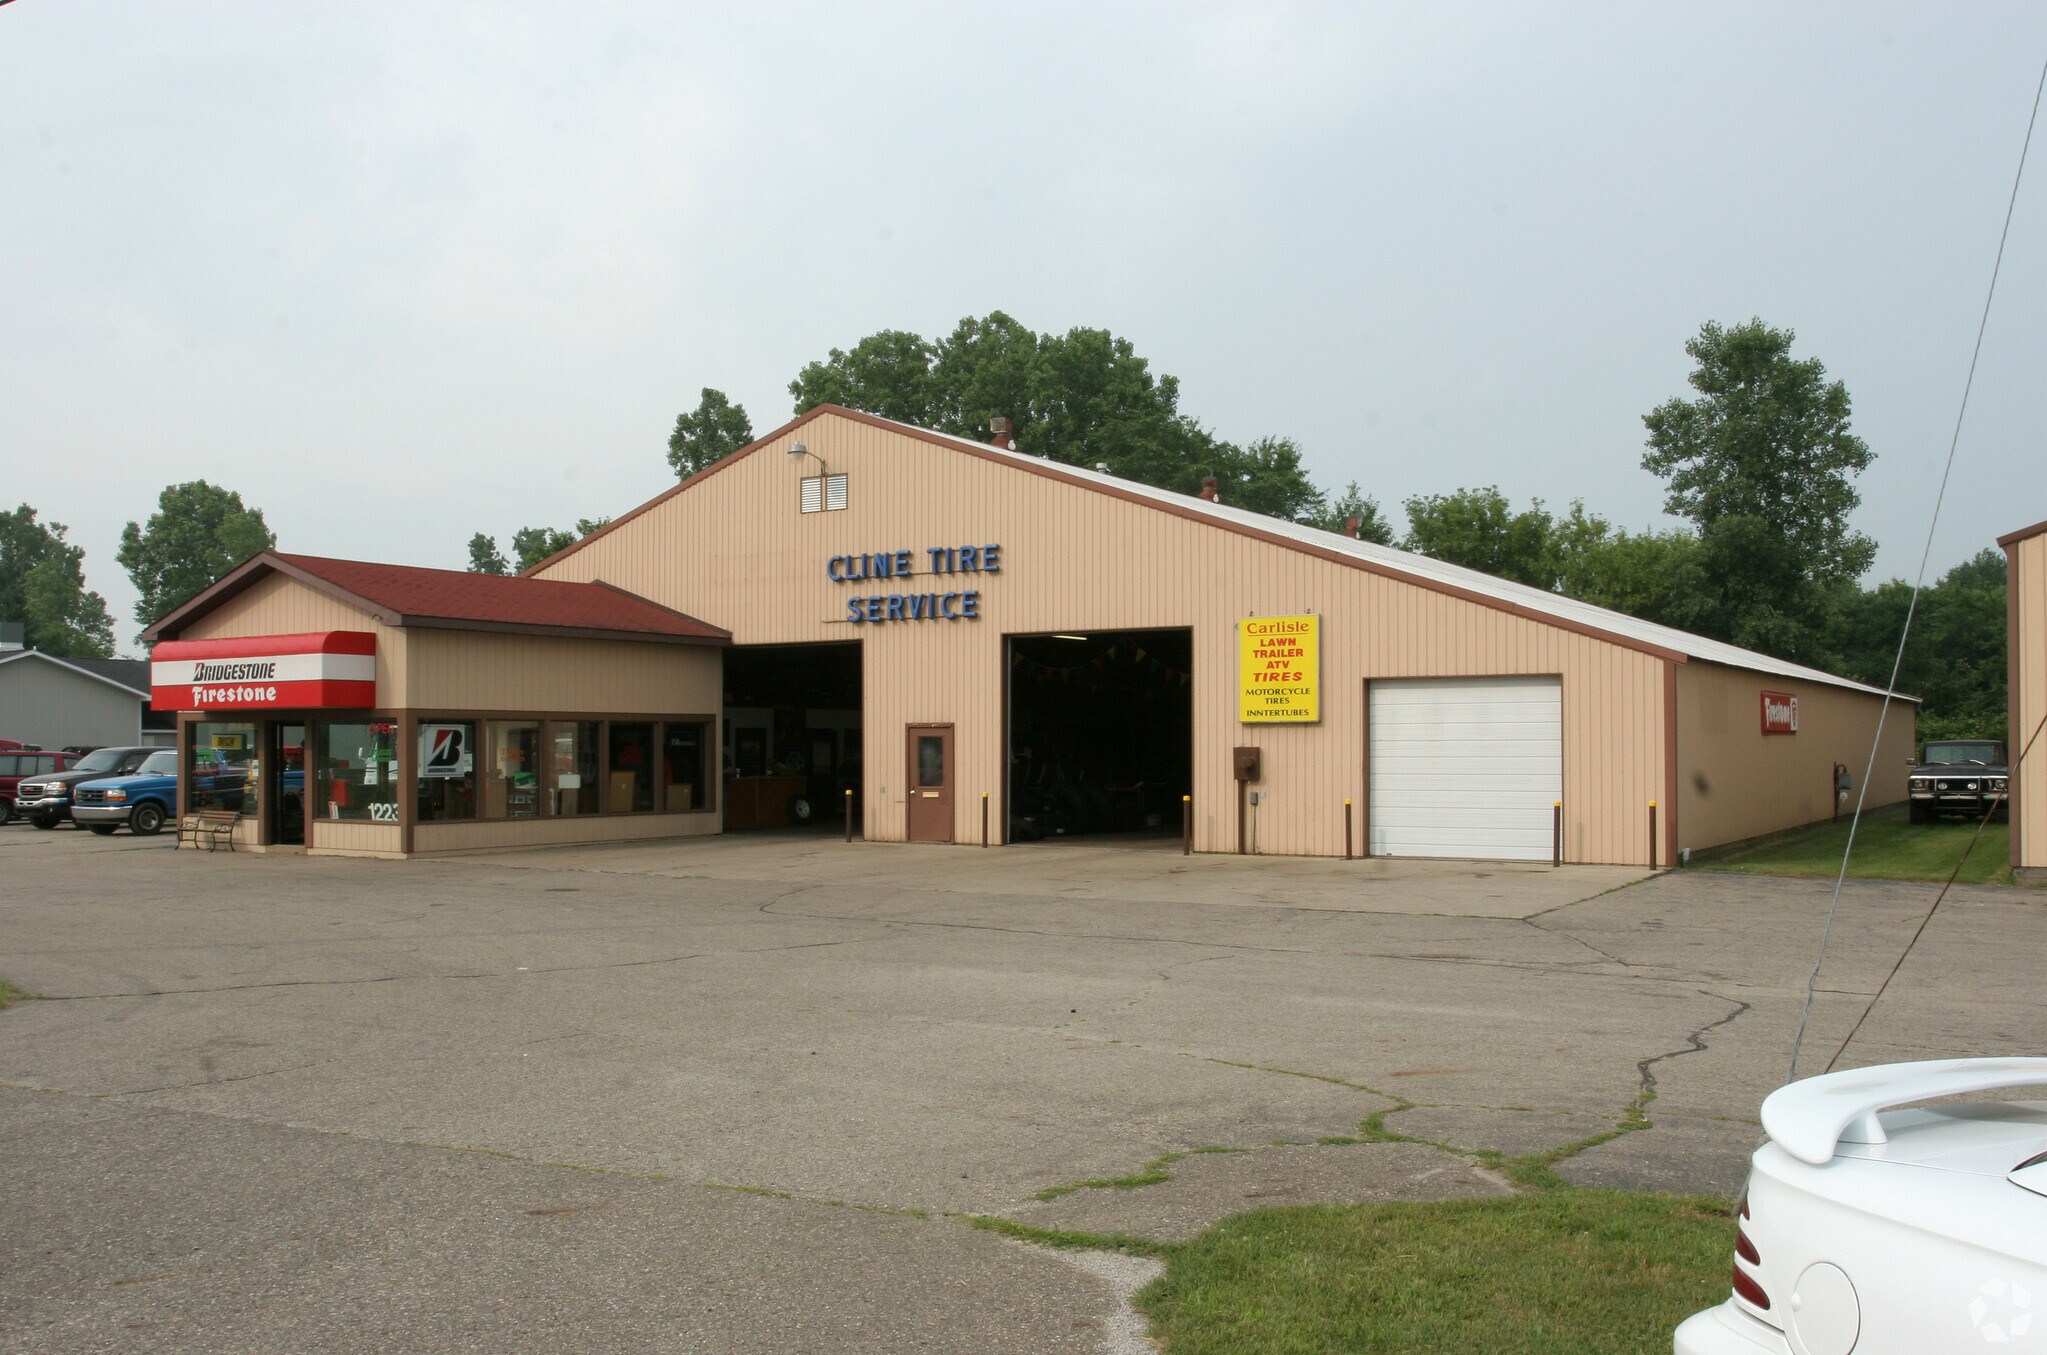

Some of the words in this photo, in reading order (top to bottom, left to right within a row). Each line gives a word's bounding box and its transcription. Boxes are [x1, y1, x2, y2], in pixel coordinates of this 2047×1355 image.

[827, 549, 911, 582] CLINE
[927, 543, 1001, 575] TIRE
[847, 590, 979, 623] SERVICE
[1246, 621, 1309, 634] Carlisle
[1260, 638, 1296, 647] LAWN
[1252, 648, 1304, 658] TRAILER
[1266, 660, 1290, 670] ATV
[193, 662, 276, 682] BRIDGESTONE
[1253, 671, 1303, 682] TIRES
[192, 685, 276, 707] Firestone
[1245, 687, 1311, 696] MOTORCYCLE
[1265, 697, 1290, 705] TIRES
[1246, 708, 1310, 717] INNTERTUBES
[368, 802, 399, 822] 1223
